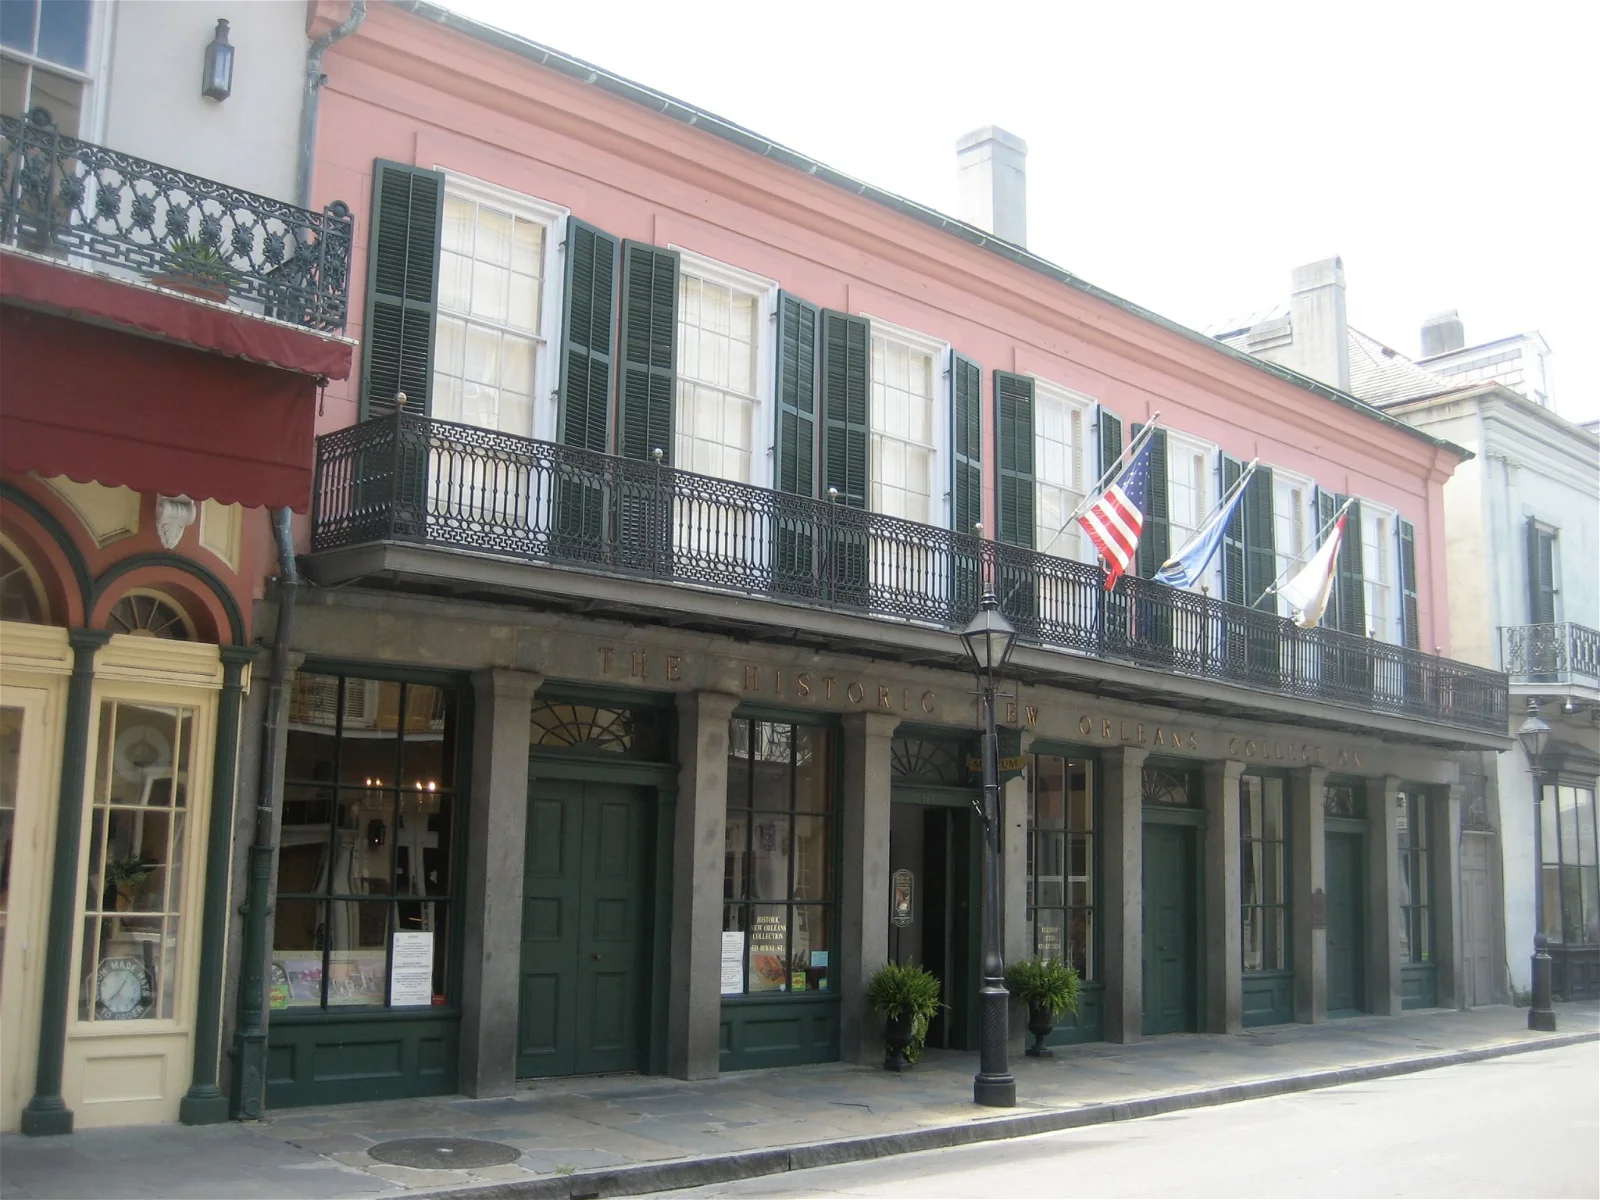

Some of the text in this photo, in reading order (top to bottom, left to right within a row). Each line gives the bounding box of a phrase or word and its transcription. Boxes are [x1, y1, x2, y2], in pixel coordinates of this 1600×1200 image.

[599, 648, 681, 682] THE
[744, 665, 936, 713] HISTORIC
[1079, 715, 1198, 751] ORLEANS
[1229, 737, 1363, 769] COLLECTION
[111, 960, 150, 997] MADE HATS
[100, 1005, 145, 1020] TO ORDER
